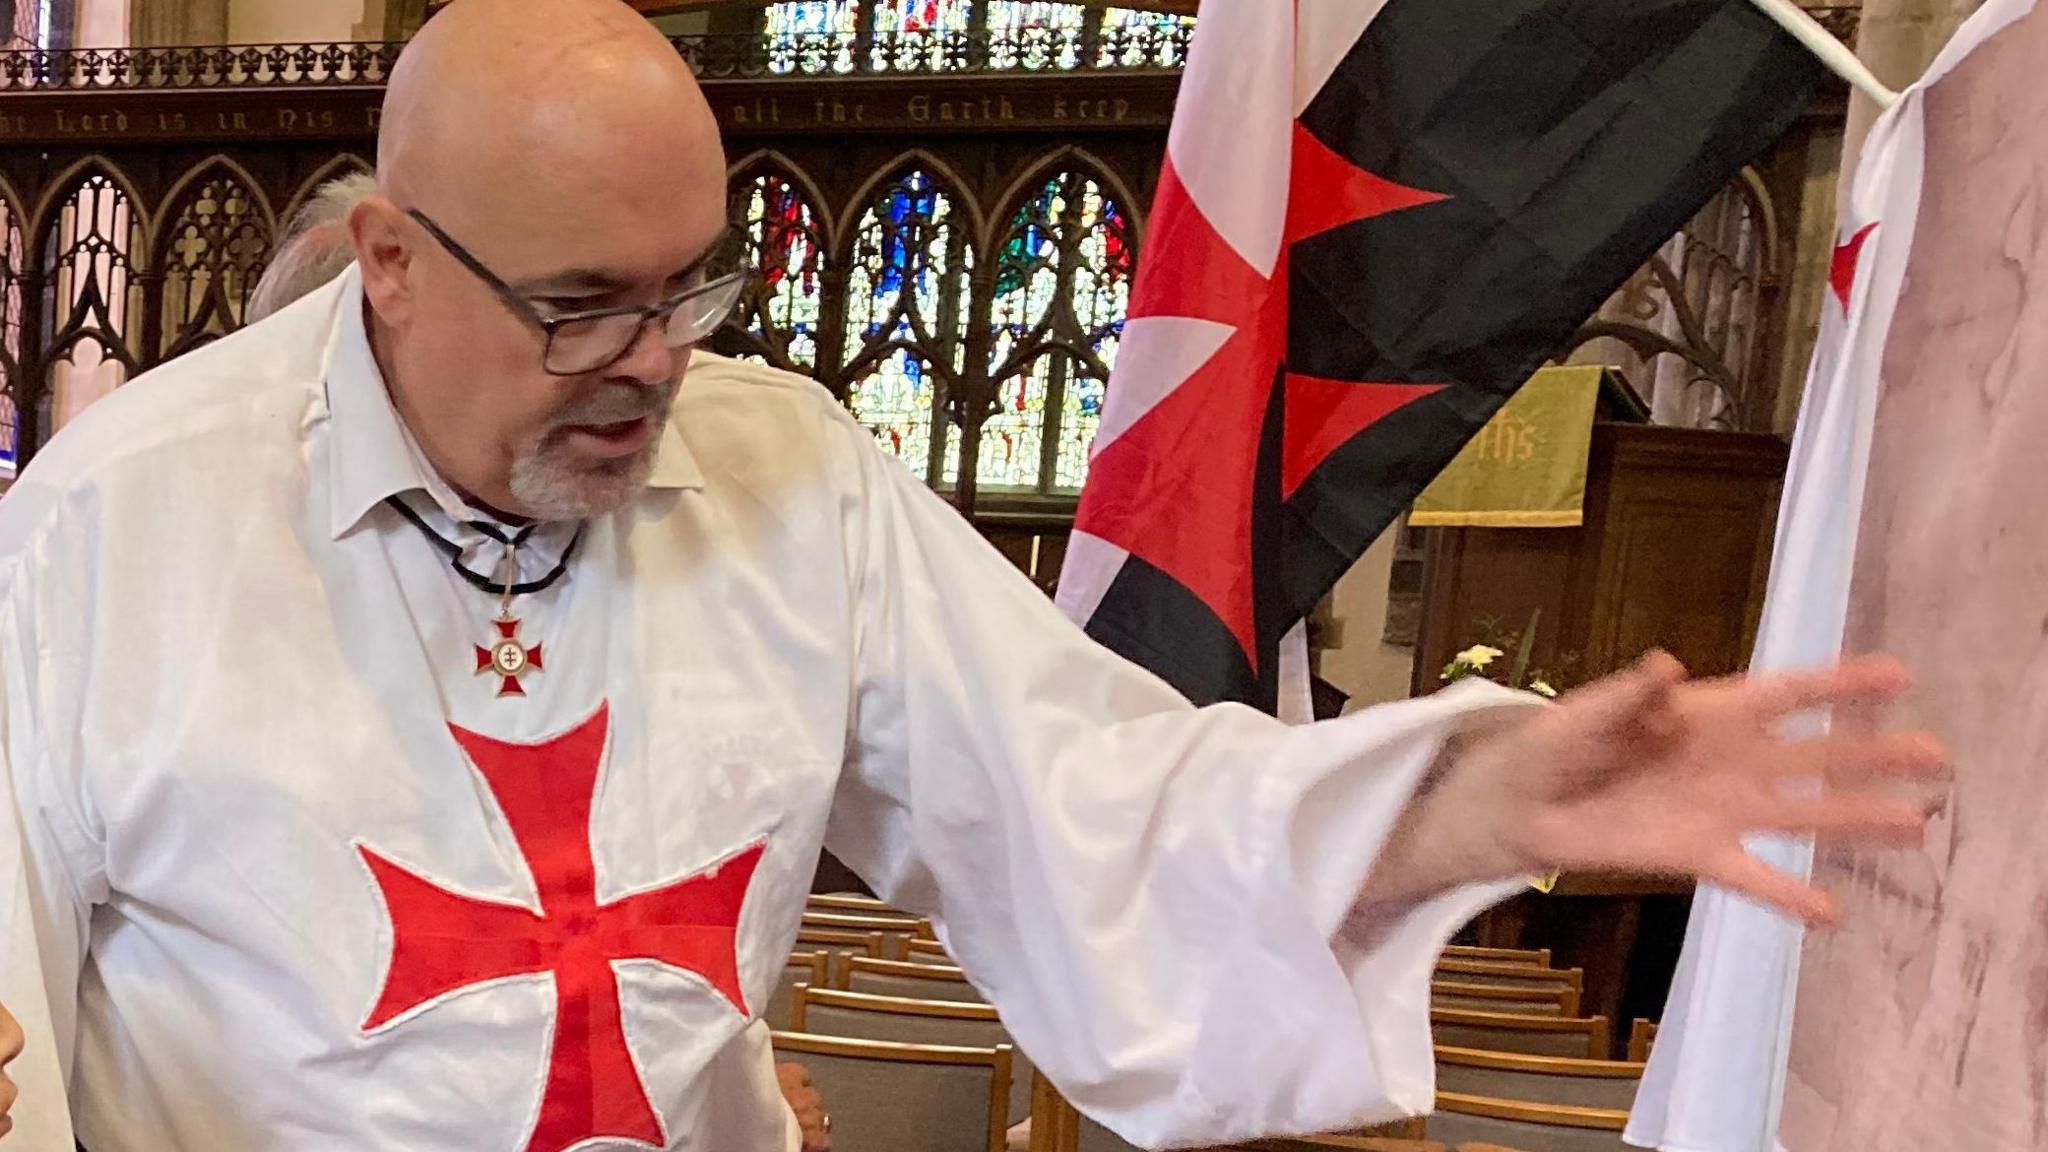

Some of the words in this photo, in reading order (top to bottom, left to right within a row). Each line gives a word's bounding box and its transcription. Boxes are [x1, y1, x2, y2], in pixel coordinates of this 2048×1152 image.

[55, 109, 127, 132] Lord
[158, 113, 186, 131] is
[218, 112, 247, 130] in
[733, 97, 779, 123] all
[815, 97, 864, 122] the
[907, 95, 1014, 121] Earth
[1053, 95, 1128, 121] keep
